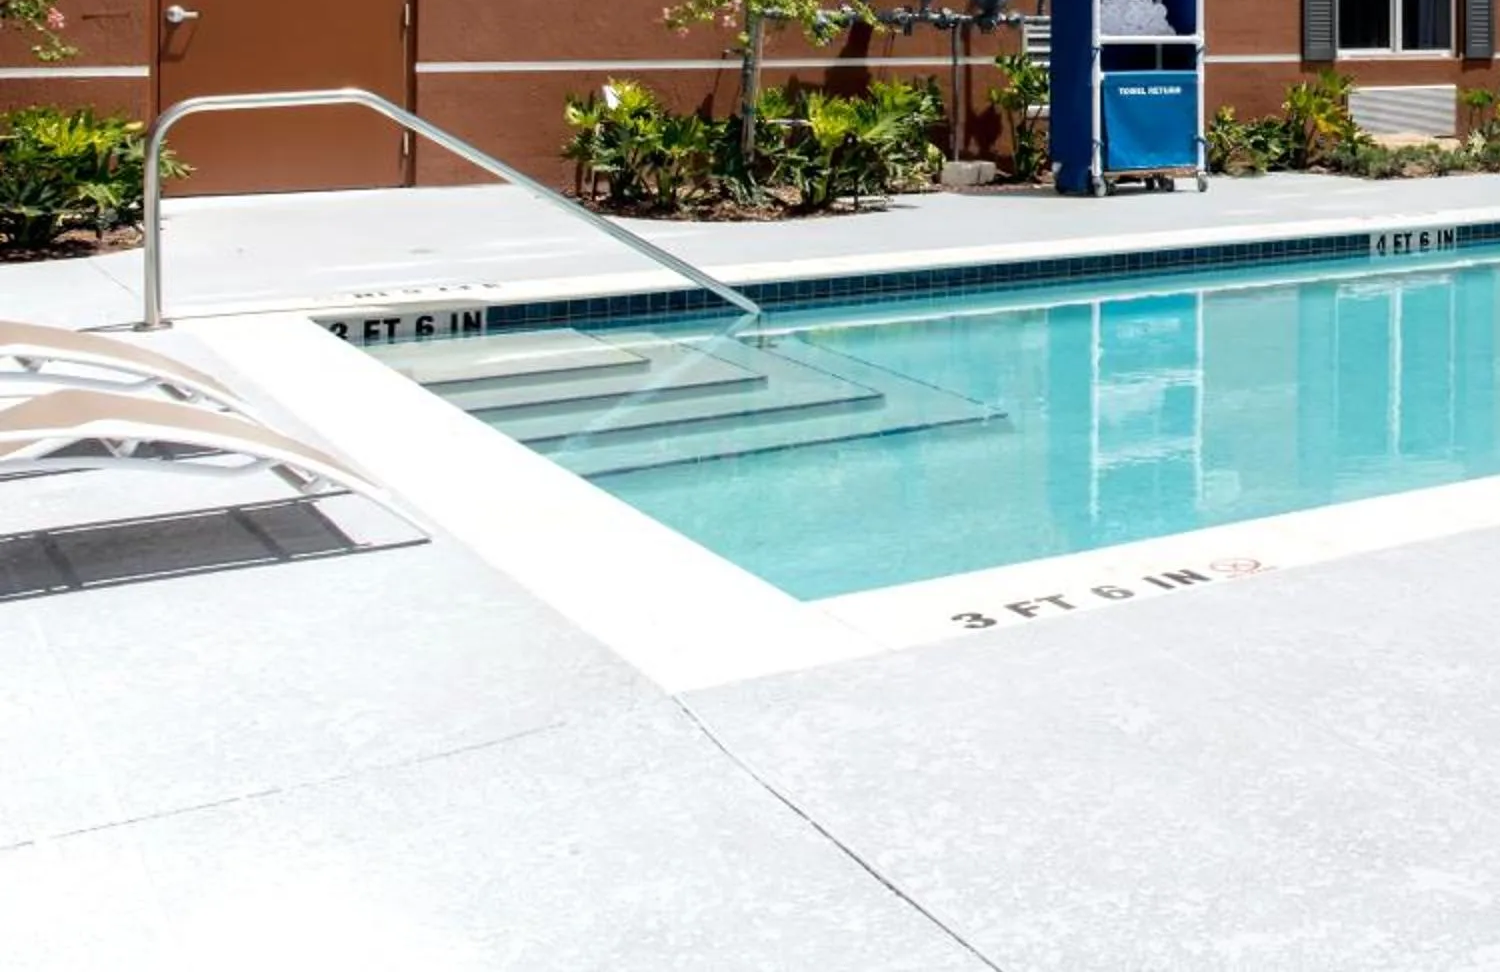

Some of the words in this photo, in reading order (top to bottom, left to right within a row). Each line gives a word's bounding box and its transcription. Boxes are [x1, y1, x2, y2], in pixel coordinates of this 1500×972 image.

[1119, 86, 1146, 95] TOWEL
[1147, 85, 1181, 95] RETURN
[1376, 234, 1386, 252] 4
[1394, 233, 1412, 251] FT
[1420, 231, 1430, 246] 6
[1438, 229, 1453, 246] IN
[364, 318, 401, 344] FT
[415, 315, 434, 337] 6
[451, 310, 481, 333] IN
[951, 612, 998, 629] 3
[1004, 594, 1076, 618] FT
[1090, 585, 1135, 600] 6
[1142, 569, 1212, 590] IN
